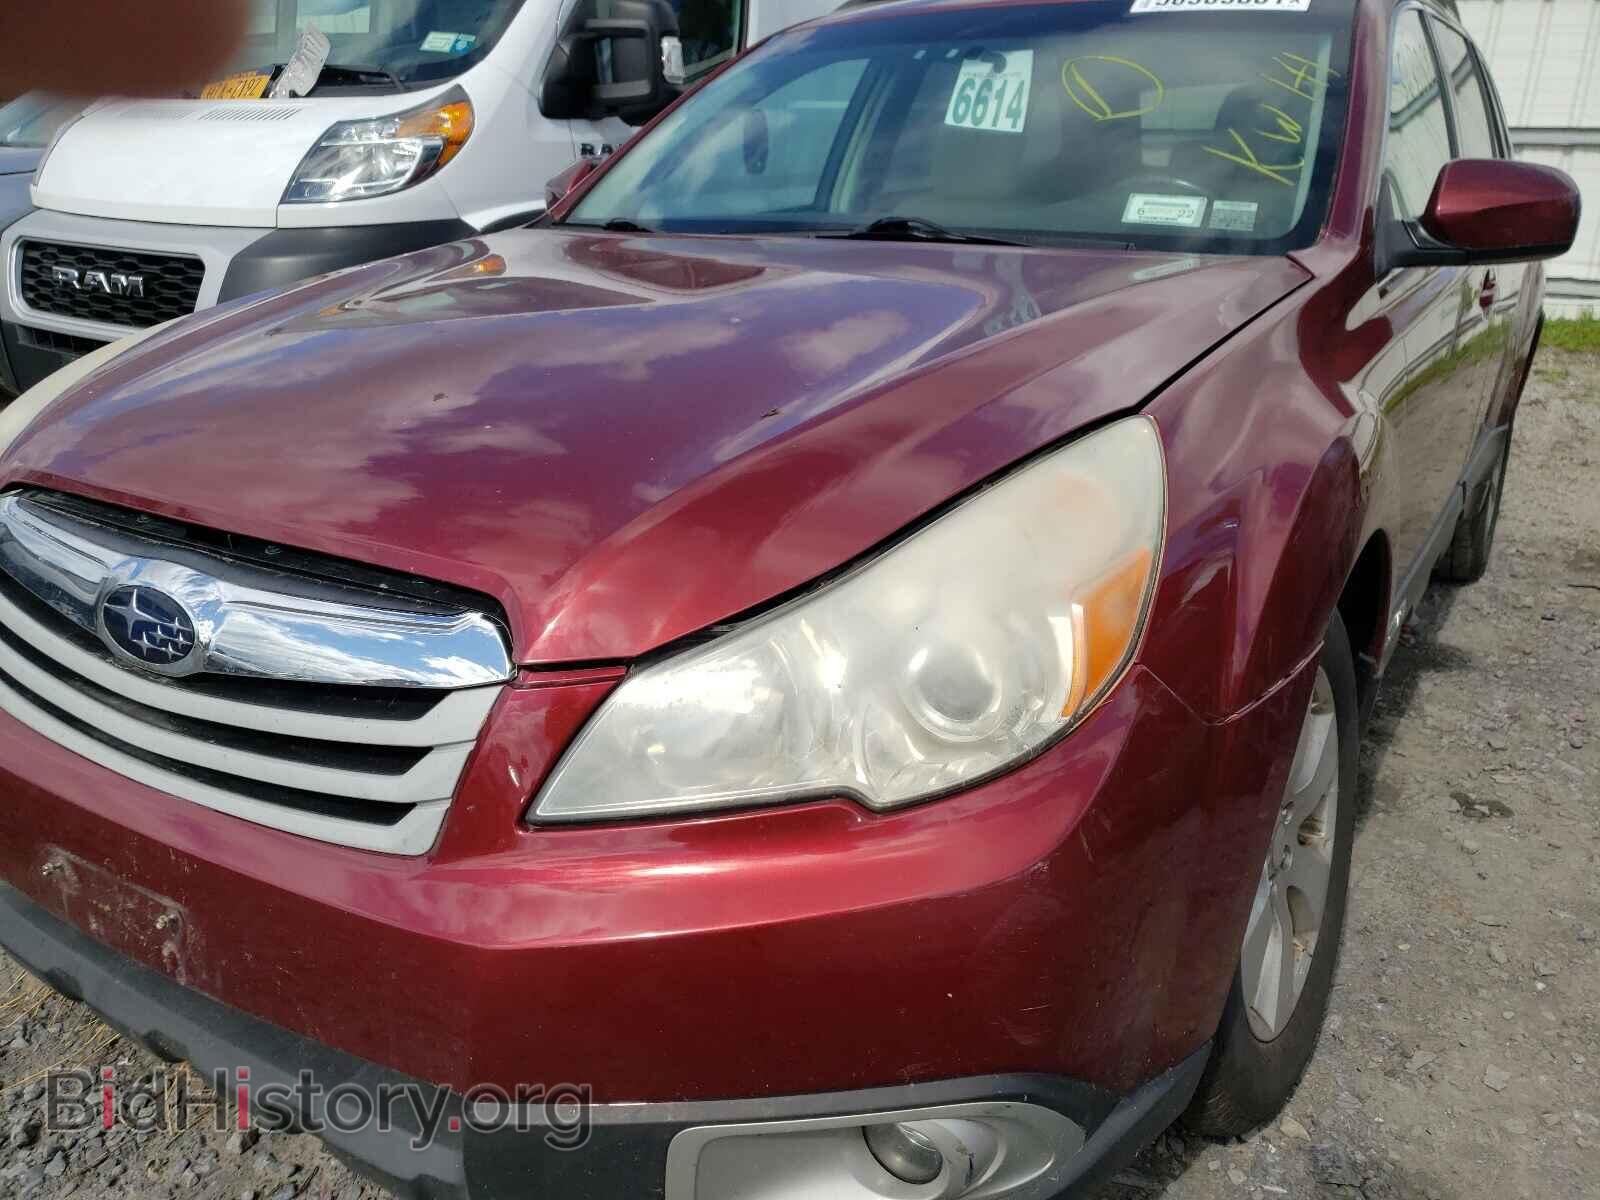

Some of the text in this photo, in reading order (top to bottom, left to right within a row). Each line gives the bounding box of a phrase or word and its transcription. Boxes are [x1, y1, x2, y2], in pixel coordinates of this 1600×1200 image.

[952, 78, 1025, 130] 6614
[581, 144, 623, 155] RA
[52, 266, 144, 297] RAM
